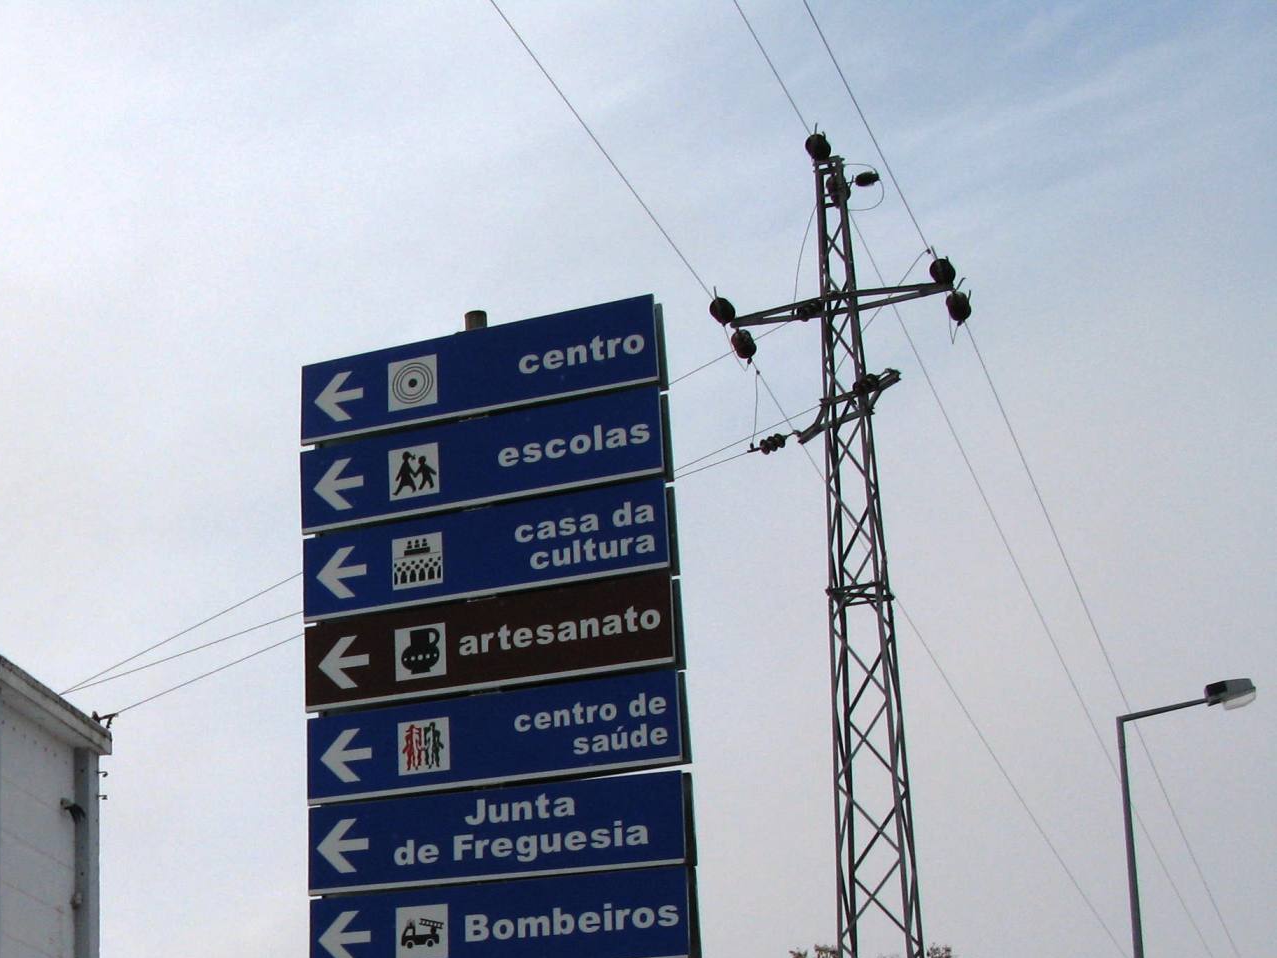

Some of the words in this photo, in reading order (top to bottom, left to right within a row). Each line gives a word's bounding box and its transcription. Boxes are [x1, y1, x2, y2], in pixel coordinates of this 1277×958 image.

[518, 333, 645, 374] centro
[497, 423, 650, 467] escolas
[514, 513, 599, 543] casa
[612, 501, 655, 527] da
[529, 533, 655, 570] cultura
[459, 605, 661, 656] artesanato
[514, 702, 617, 732] centro
[629, 692, 667, 718] de
[573, 723, 668, 755] saúde
[465, 793, 575, 826] Junta
[394, 839, 439, 866] de
[453, 820, 649, 862] Freguesia
[465, 903, 679, 942] Bombeiros
